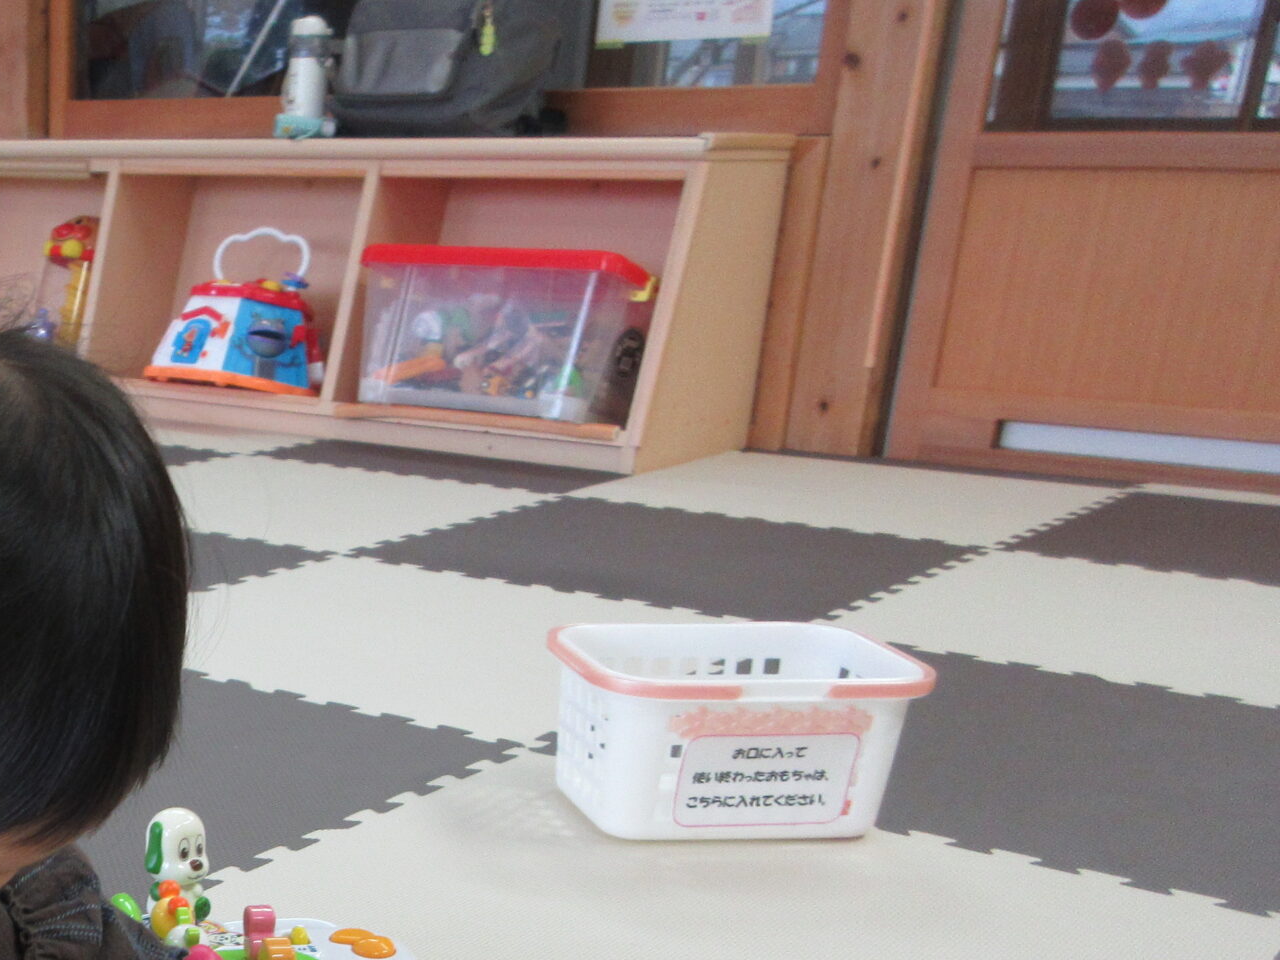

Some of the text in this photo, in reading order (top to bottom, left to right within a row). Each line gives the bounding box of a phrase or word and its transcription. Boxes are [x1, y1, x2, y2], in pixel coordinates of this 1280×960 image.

[732, 747, 808, 759] お口に入って
